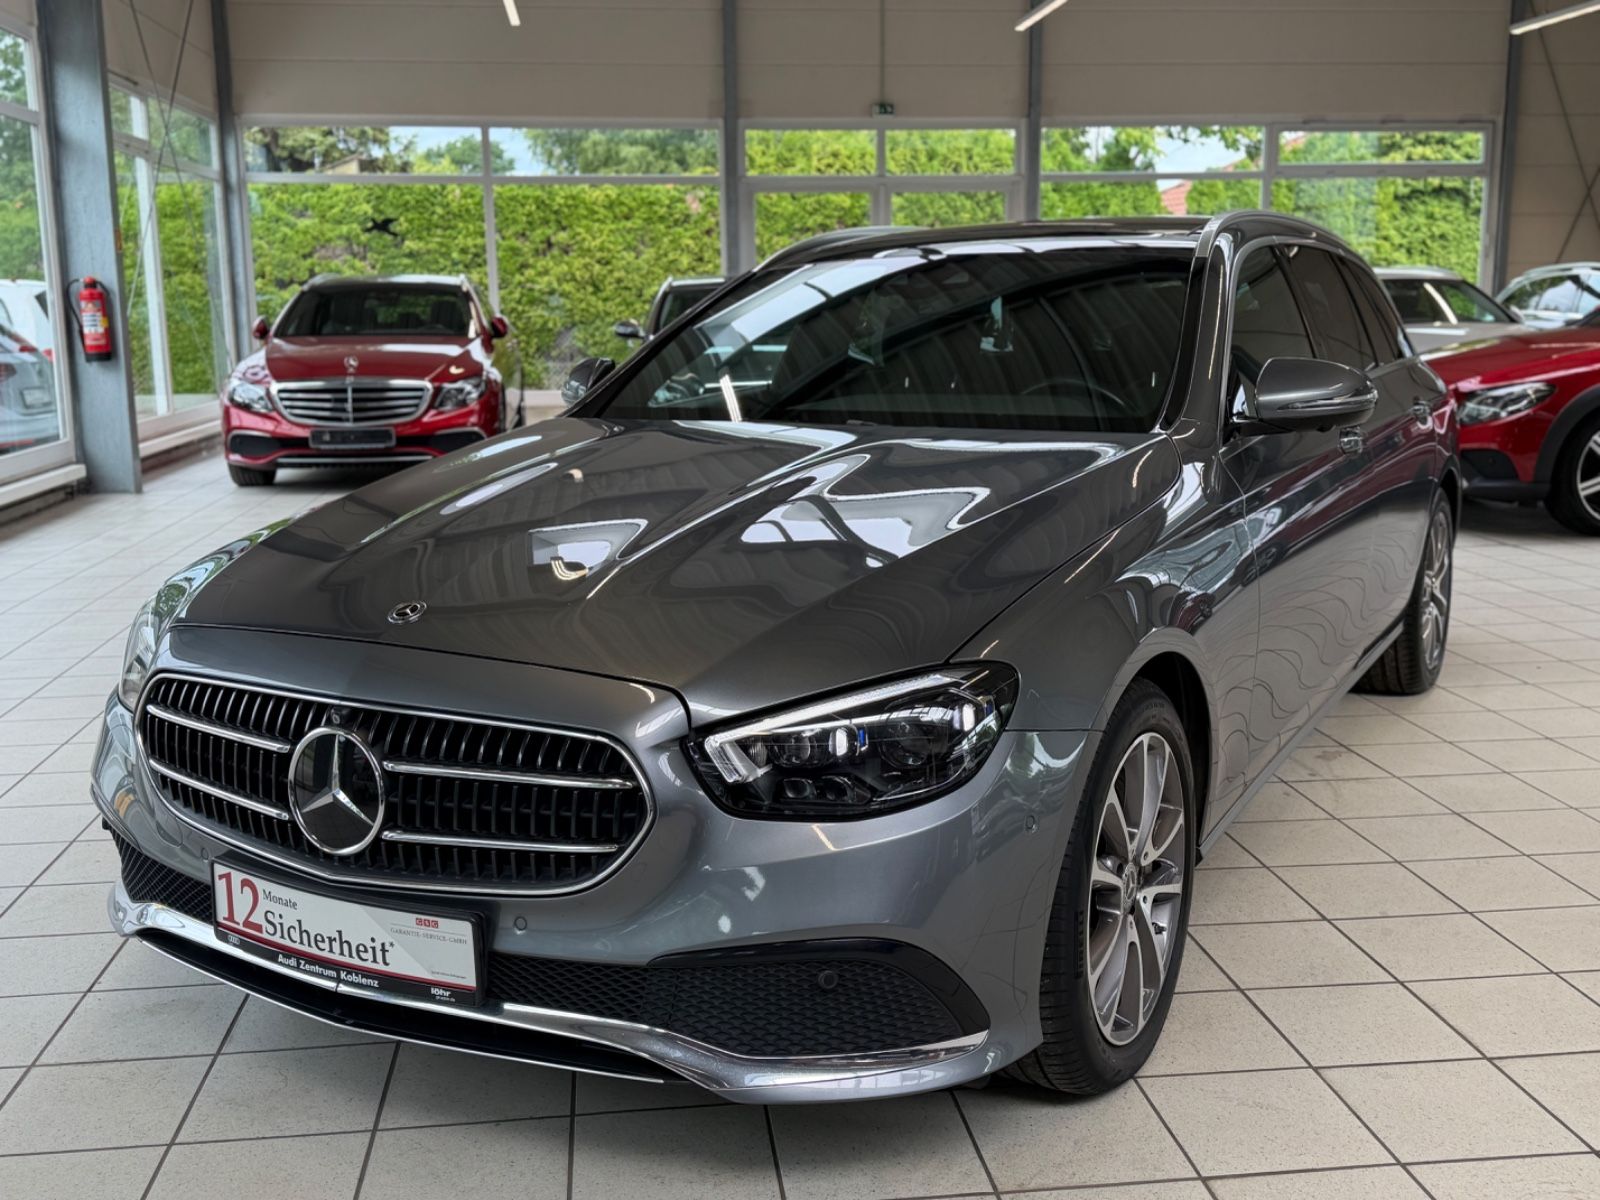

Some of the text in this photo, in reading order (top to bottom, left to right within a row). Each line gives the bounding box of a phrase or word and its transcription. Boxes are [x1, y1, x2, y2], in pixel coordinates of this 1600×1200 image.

[217, 871, 264, 935] 12
[262, 888, 298, 911] Monate
[277, 953, 380, 988] Audi Zentrum Koblenz
